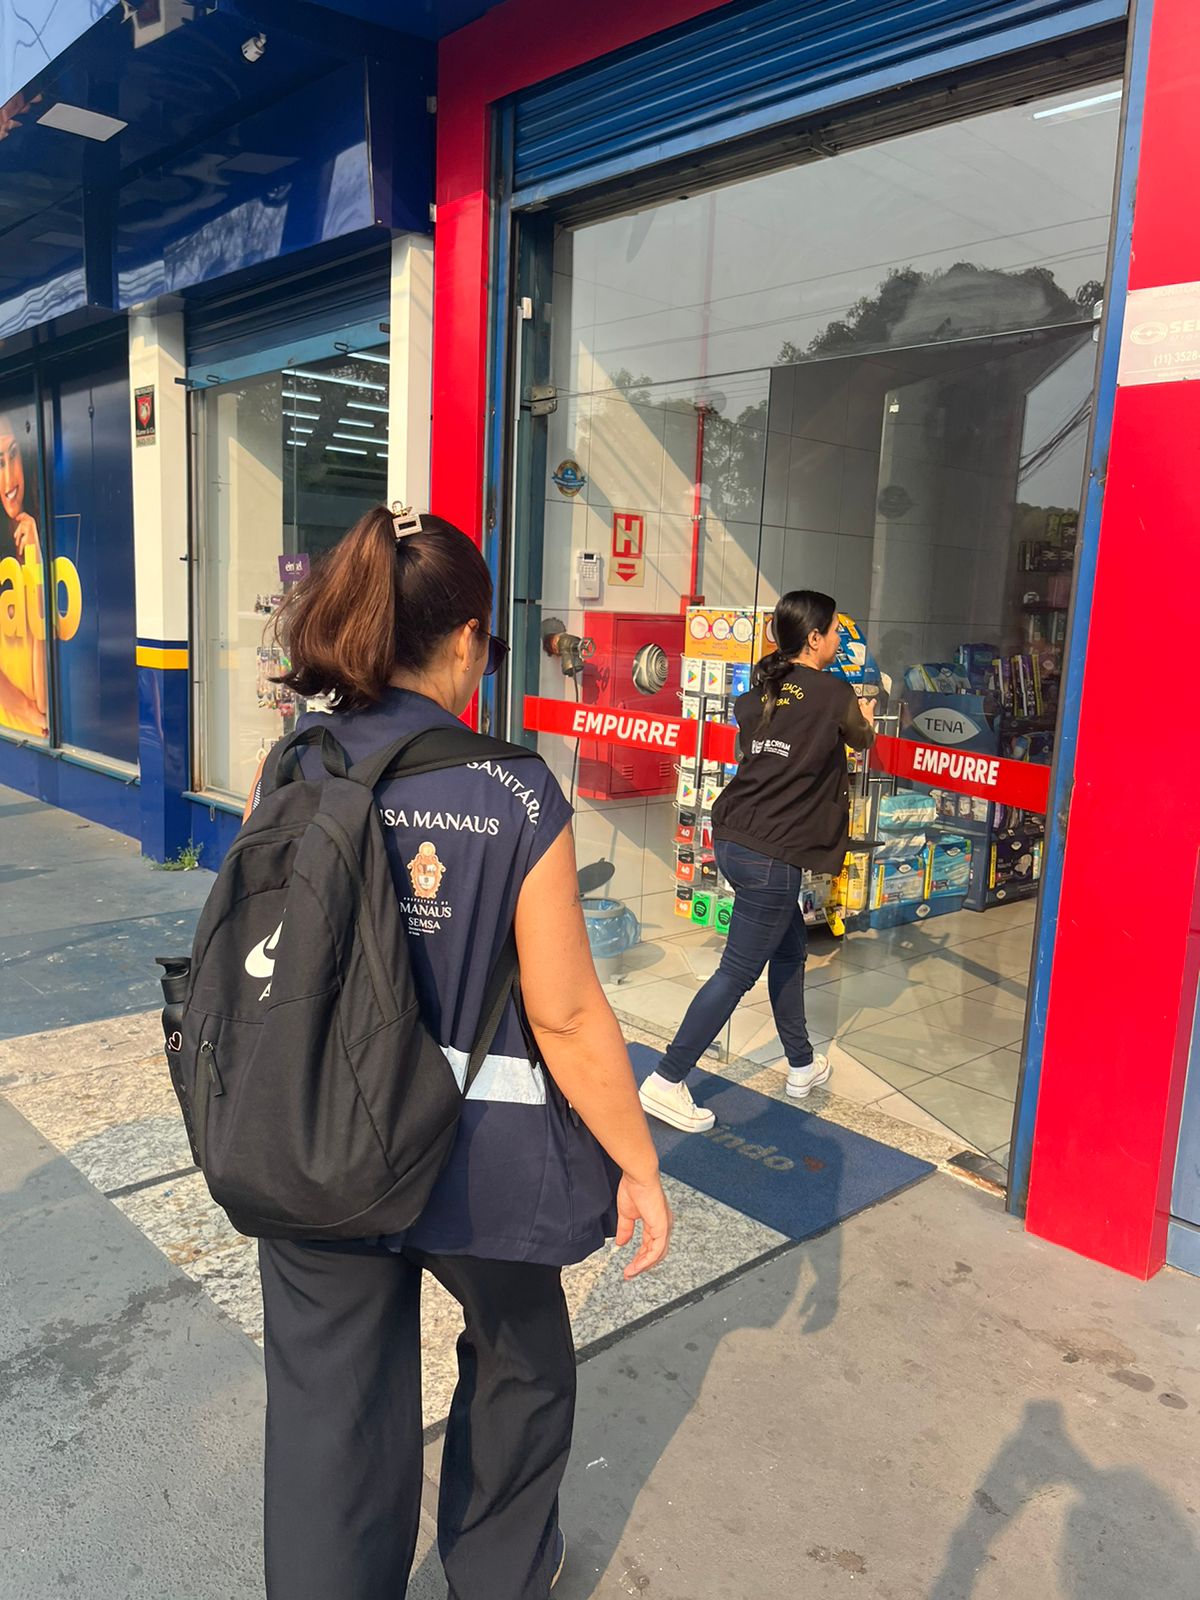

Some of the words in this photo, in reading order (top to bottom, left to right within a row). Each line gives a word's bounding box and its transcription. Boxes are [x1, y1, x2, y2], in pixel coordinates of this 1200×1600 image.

[572, 709, 680, 747] EMPURRE
[924, 717, 963, 734] TENA
[912, 747, 1000, 786] EMPURRE
[413, 810, 500, 836] MANAUS
[399, 901, 452, 918] MANAUS
[408, 917, 441, 930] SEMSA
